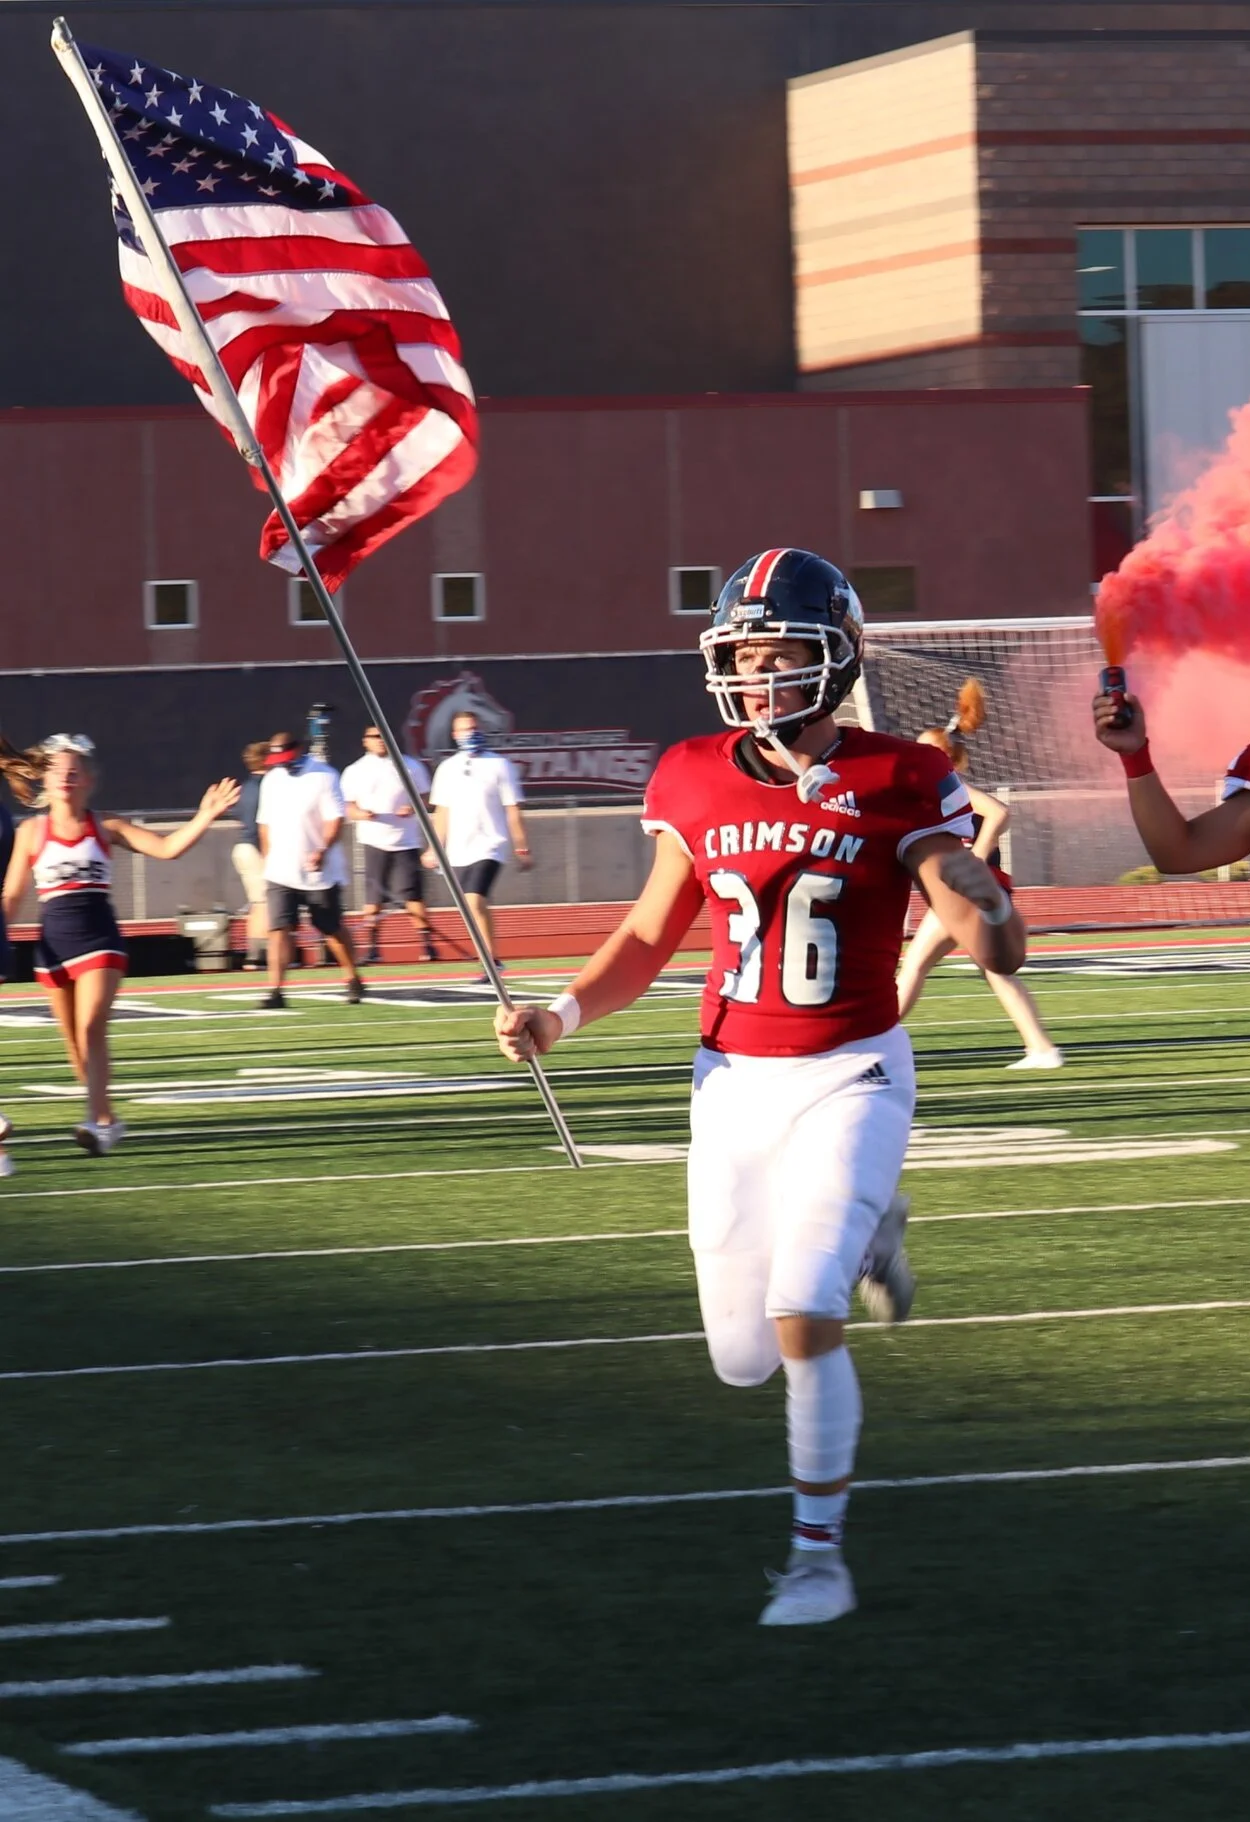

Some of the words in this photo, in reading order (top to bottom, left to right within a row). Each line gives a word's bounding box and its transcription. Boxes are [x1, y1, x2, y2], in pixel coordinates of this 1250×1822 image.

[820, 801, 862, 818] adidas
[704, 821, 867, 864] CRIMSON
[708, 868, 846, 1007] 36
